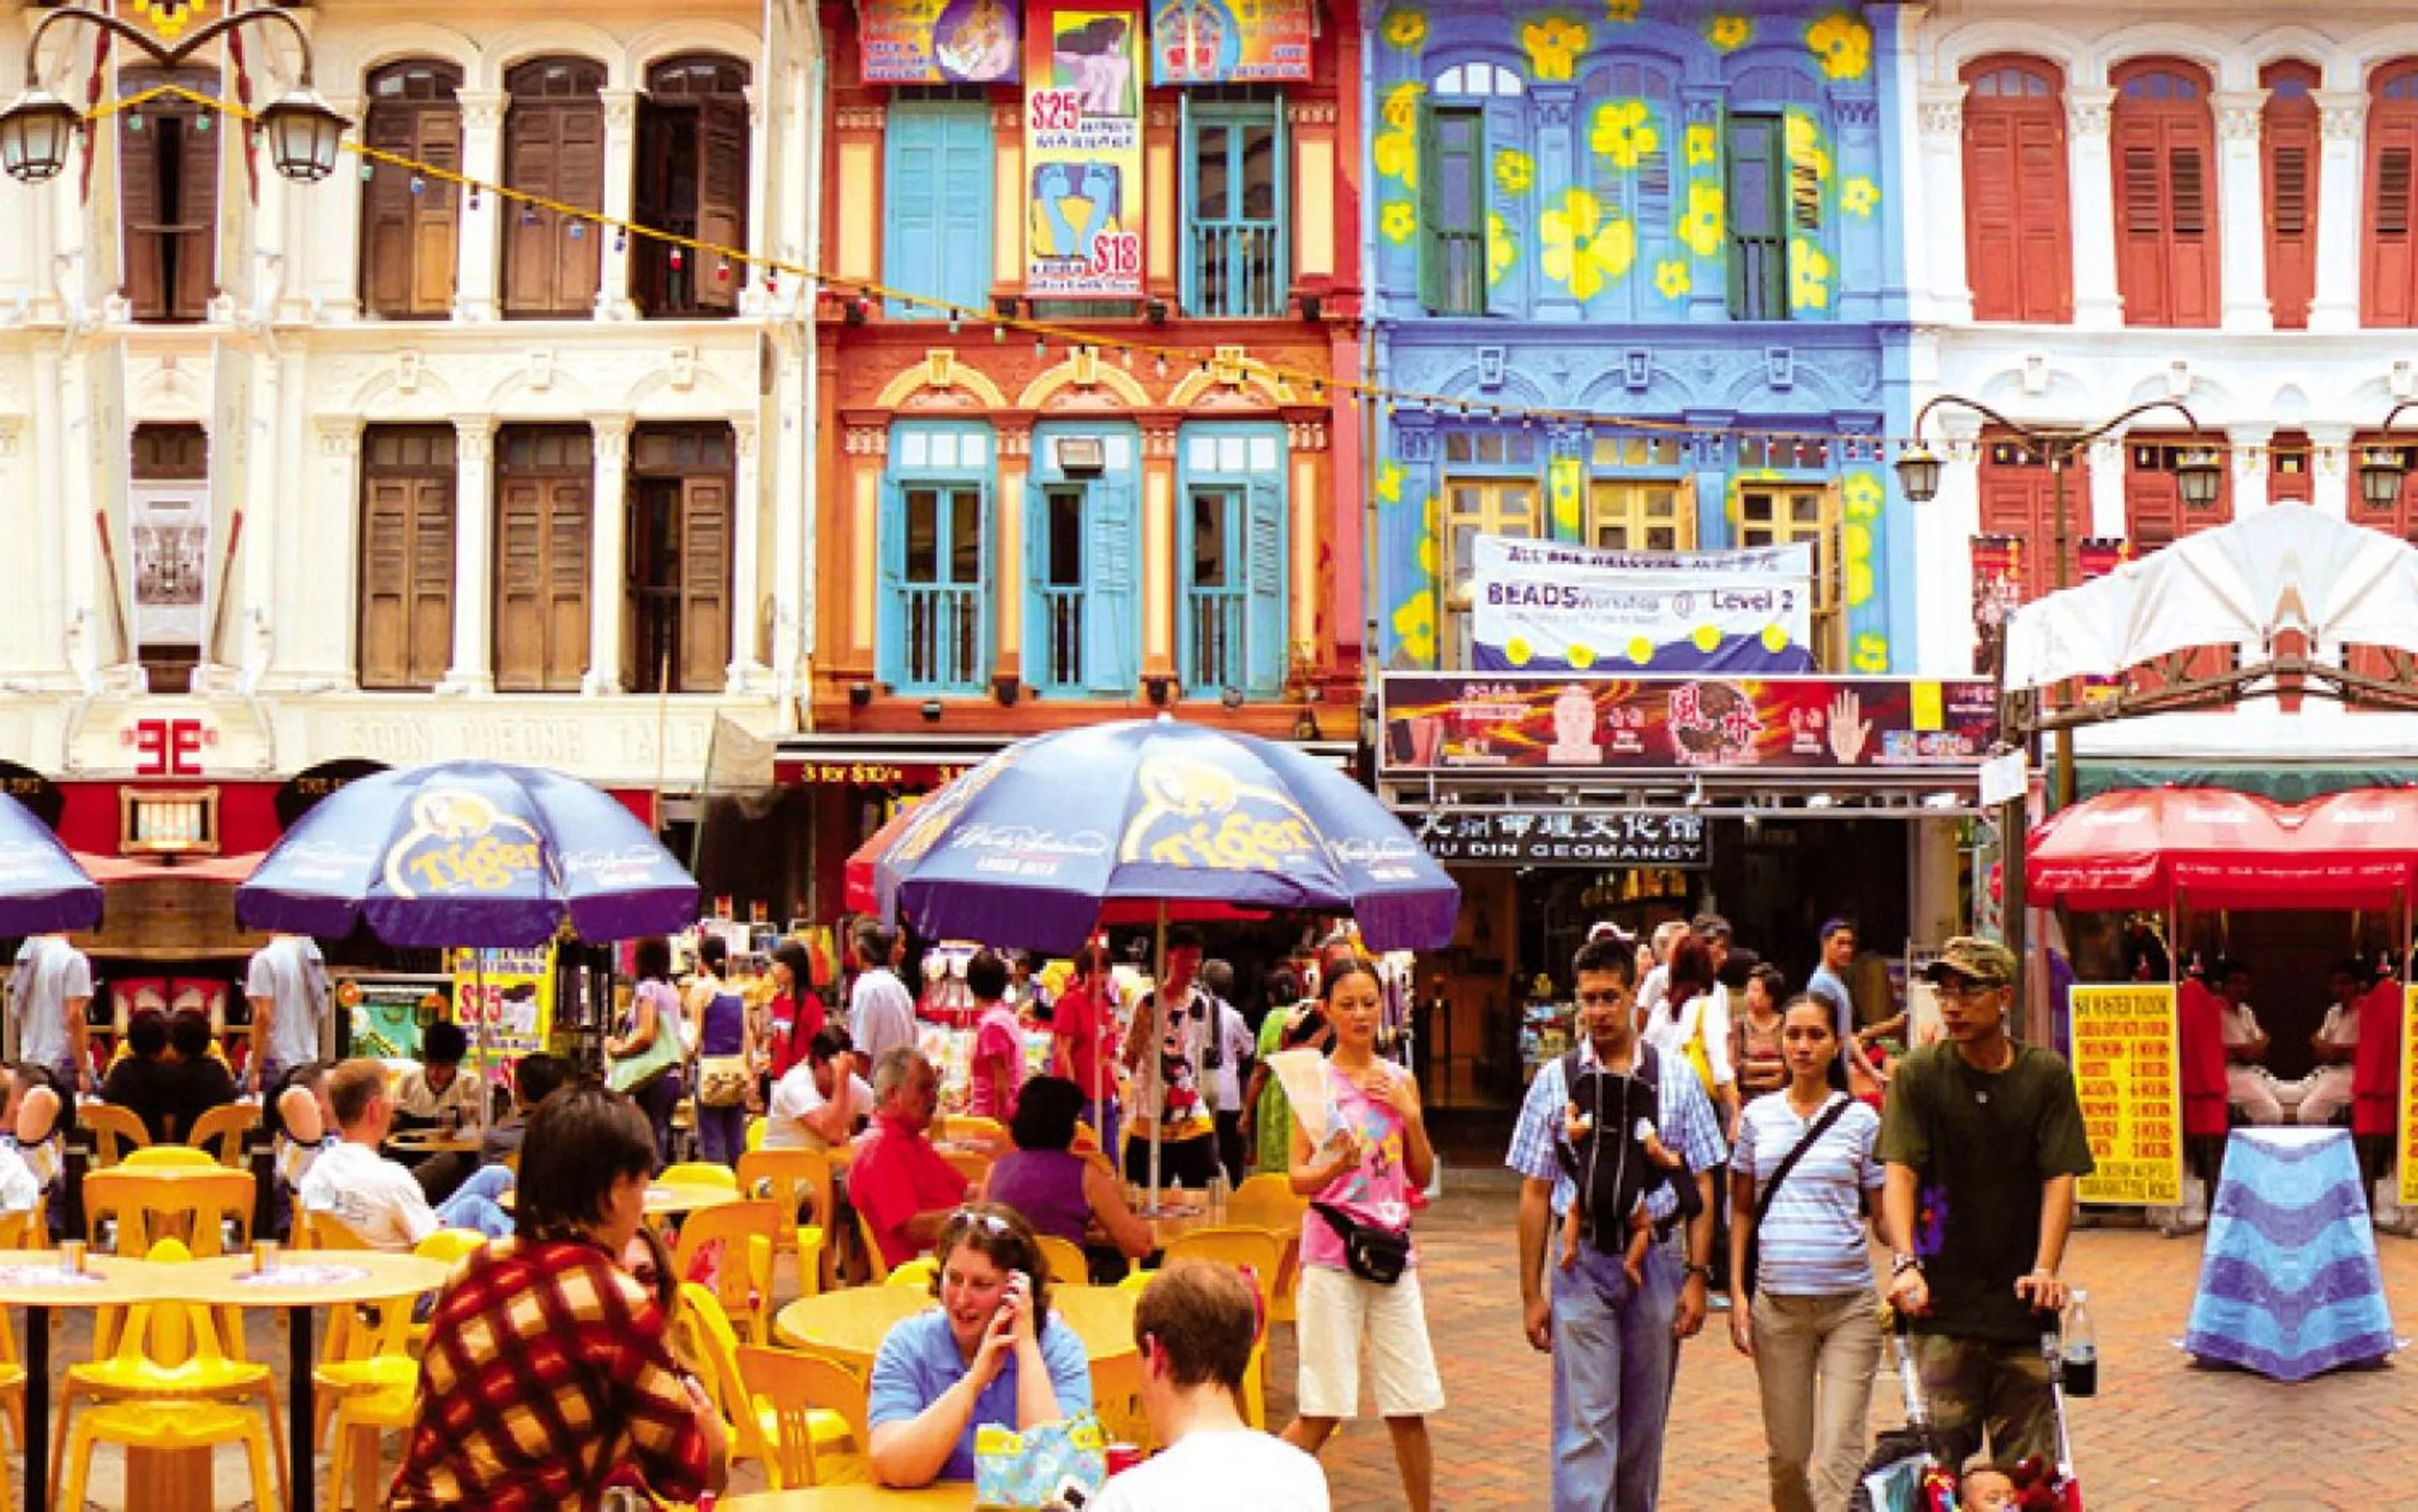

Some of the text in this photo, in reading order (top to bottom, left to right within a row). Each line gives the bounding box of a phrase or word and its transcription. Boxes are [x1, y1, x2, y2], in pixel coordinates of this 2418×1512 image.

[1032, 91, 1079, 129] $25
[1094, 234, 1138, 273] $18
[1711, 589, 1773, 613] Level
[1781, 589, 1795, 613] 2
[409, 837, 540, 890] Tiger
[1470, 843, 1518, 857] DIN
[1529, 842, 1701, 860] GEOMANCY
